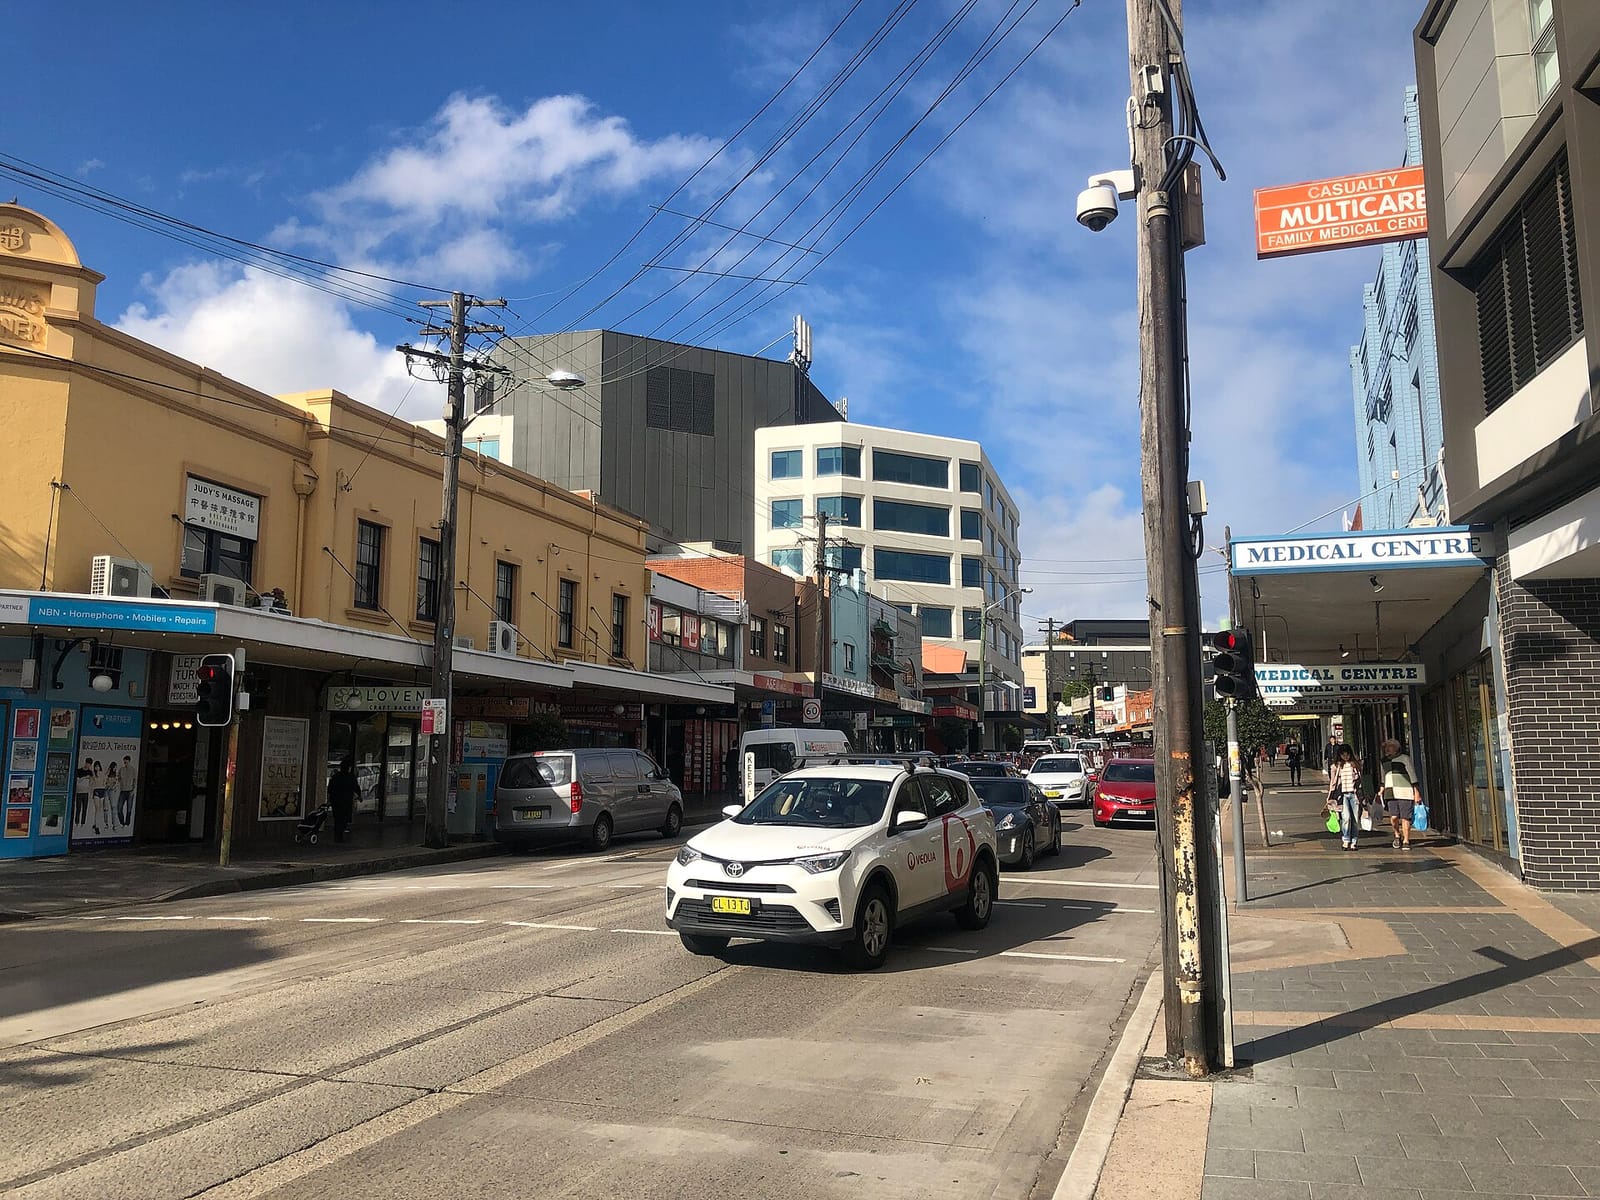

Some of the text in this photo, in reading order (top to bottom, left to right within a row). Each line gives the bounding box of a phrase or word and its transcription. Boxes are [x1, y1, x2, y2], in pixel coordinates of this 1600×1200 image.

[1308, 175, 1399, 199] CASUALTY
[1280, 189, 1427, 229] MULTICARE
[1268, 231, 1314, 247] FAMILY
[1319, 221, 1382, 241] MEDICAL
[193, 484, 255, 509] JUDY'S MASSAGE
[1248, 536, 1482, 563] MEDICAL CENTRE
[38, 607, 207, 626] NBN Homephone Mobiles Repairs
[1254, 667, 1418, 681] MEDICAL CENTRE
[366, 688, 425, 702] L'OVEN
[1264, 684, 1403, 693] MEDICAL CENTRE
[113, 742, 137, 751] Telstra
[267, 765, 297, 779] SALE
[915, 851, 937, 865] VEOLIA
